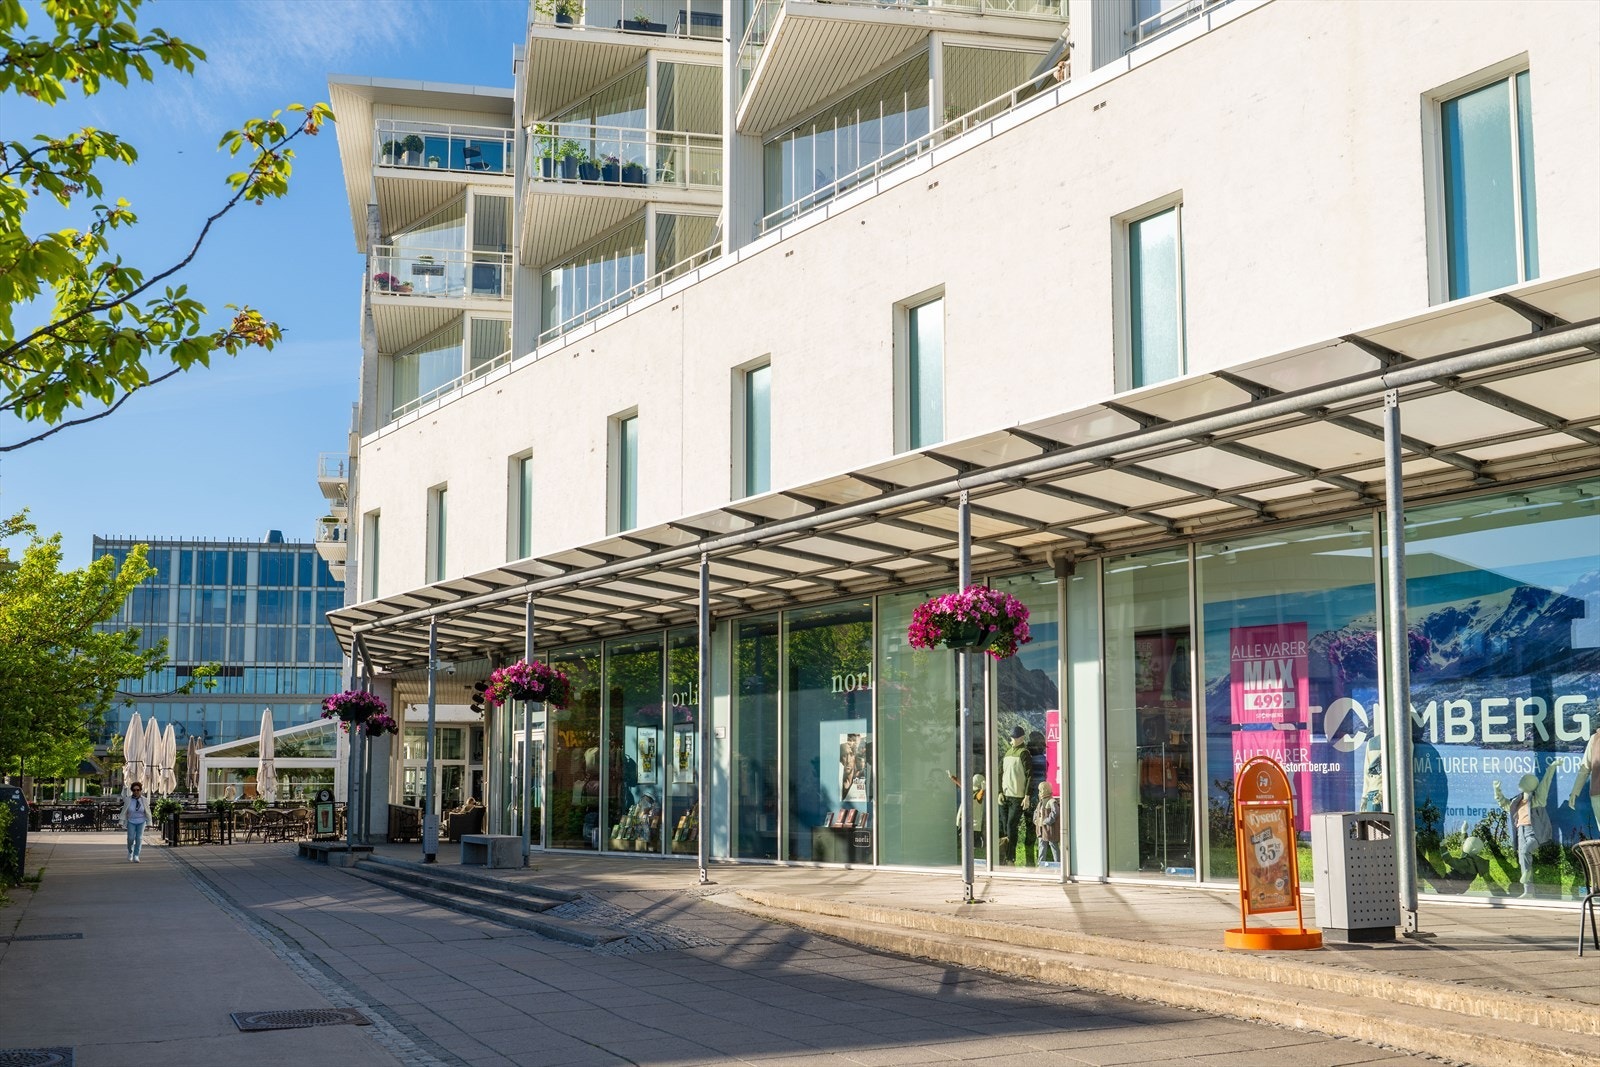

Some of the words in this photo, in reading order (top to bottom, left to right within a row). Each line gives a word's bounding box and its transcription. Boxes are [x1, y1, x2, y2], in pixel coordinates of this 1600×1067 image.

[1231, 644, 1262, 659] ALLE
[1263, 640, 1307, 657] VARER
[831, 661, 873, 693] norl
[1243, 658, 1295, 691] MAX
[662, 682, 699, 708] orli
[1266, 748, 1310, 763] VARER
[1414, 752, 1433, 774] MÅ
[1438, 756, 1479, 774] TURER
[1483, 756, 1500, 774] ER
[1504, 752, 1541, 774] OGSÅ
[1545, 755, 1582, 774] STOR
[1259, 844, 1276, 863] 35
